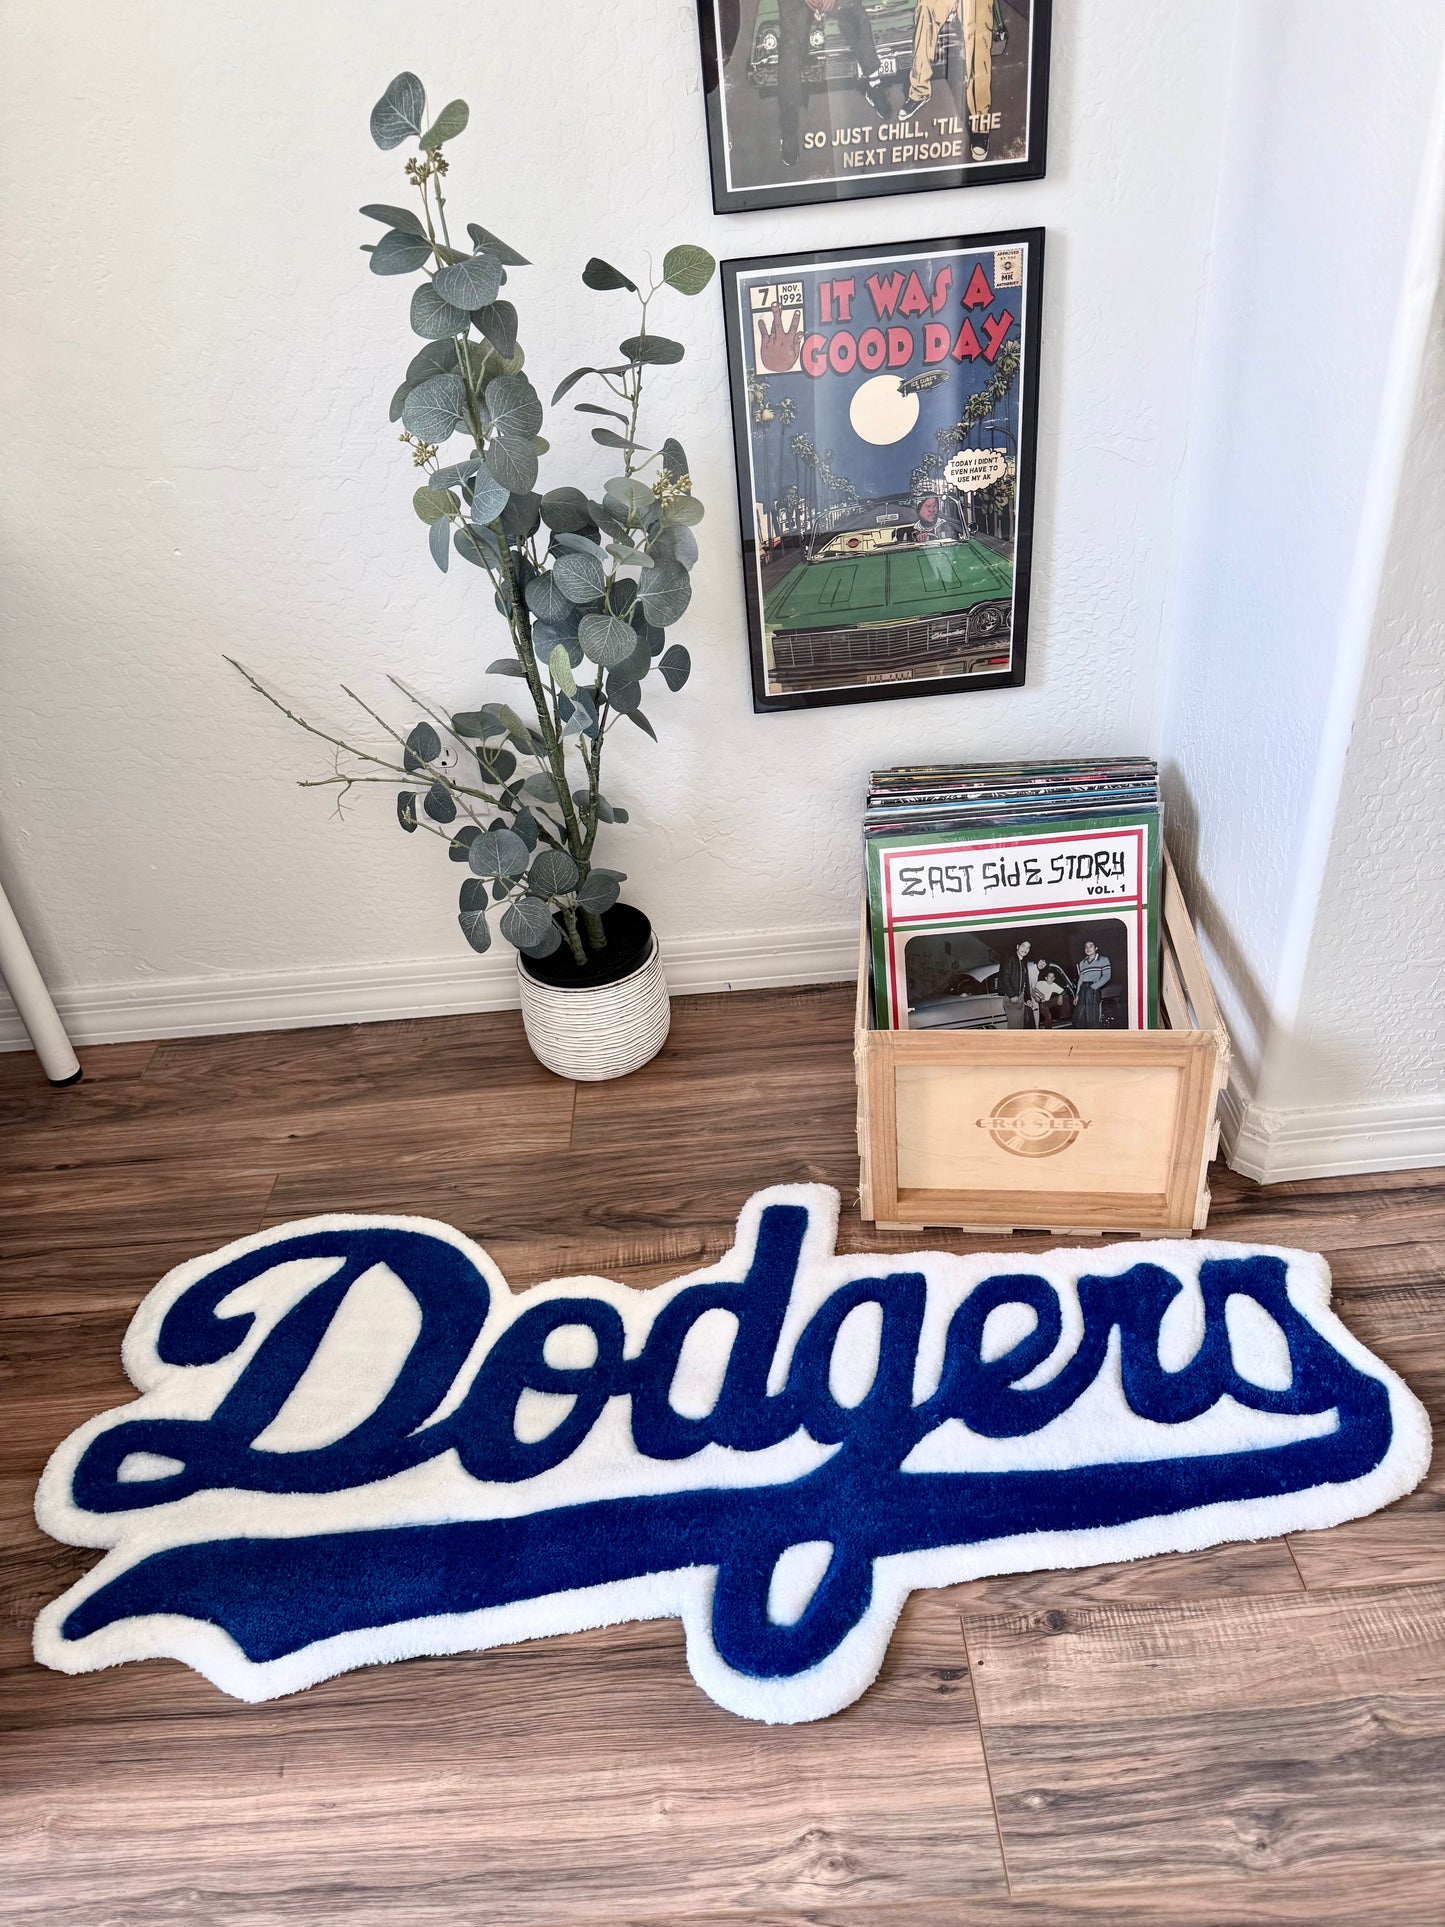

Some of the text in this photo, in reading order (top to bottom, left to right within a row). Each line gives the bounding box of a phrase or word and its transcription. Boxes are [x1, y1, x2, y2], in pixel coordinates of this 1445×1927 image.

[804, 112, 1001, 149] SO JUST CHILL, 'TIL THE
[843, 140, 963, 168] NEXT EPISODE
[758, 288, 769, 306] 7
[782, 285, 800, 293] NOV.
[819, 262, 995, 323] IT WAS A
[780, 293, 802, 304] 1992
[801, 309, 1015, 377] GOOD DAY
[951, 460, 973, 468] TODAY
[978, 457, 998, 465] DIDN'T
[969, 466, 987, 474] HAVE
[900, 865, 974, 897] EAST
[1048, 851, 1125, 884] STORY
[1087, 884, 1126, 895] VOL. 1
[975, 1118, 1093, 1129] CROSLEY
[66, 1202, 1393, 1681] Dodgers
